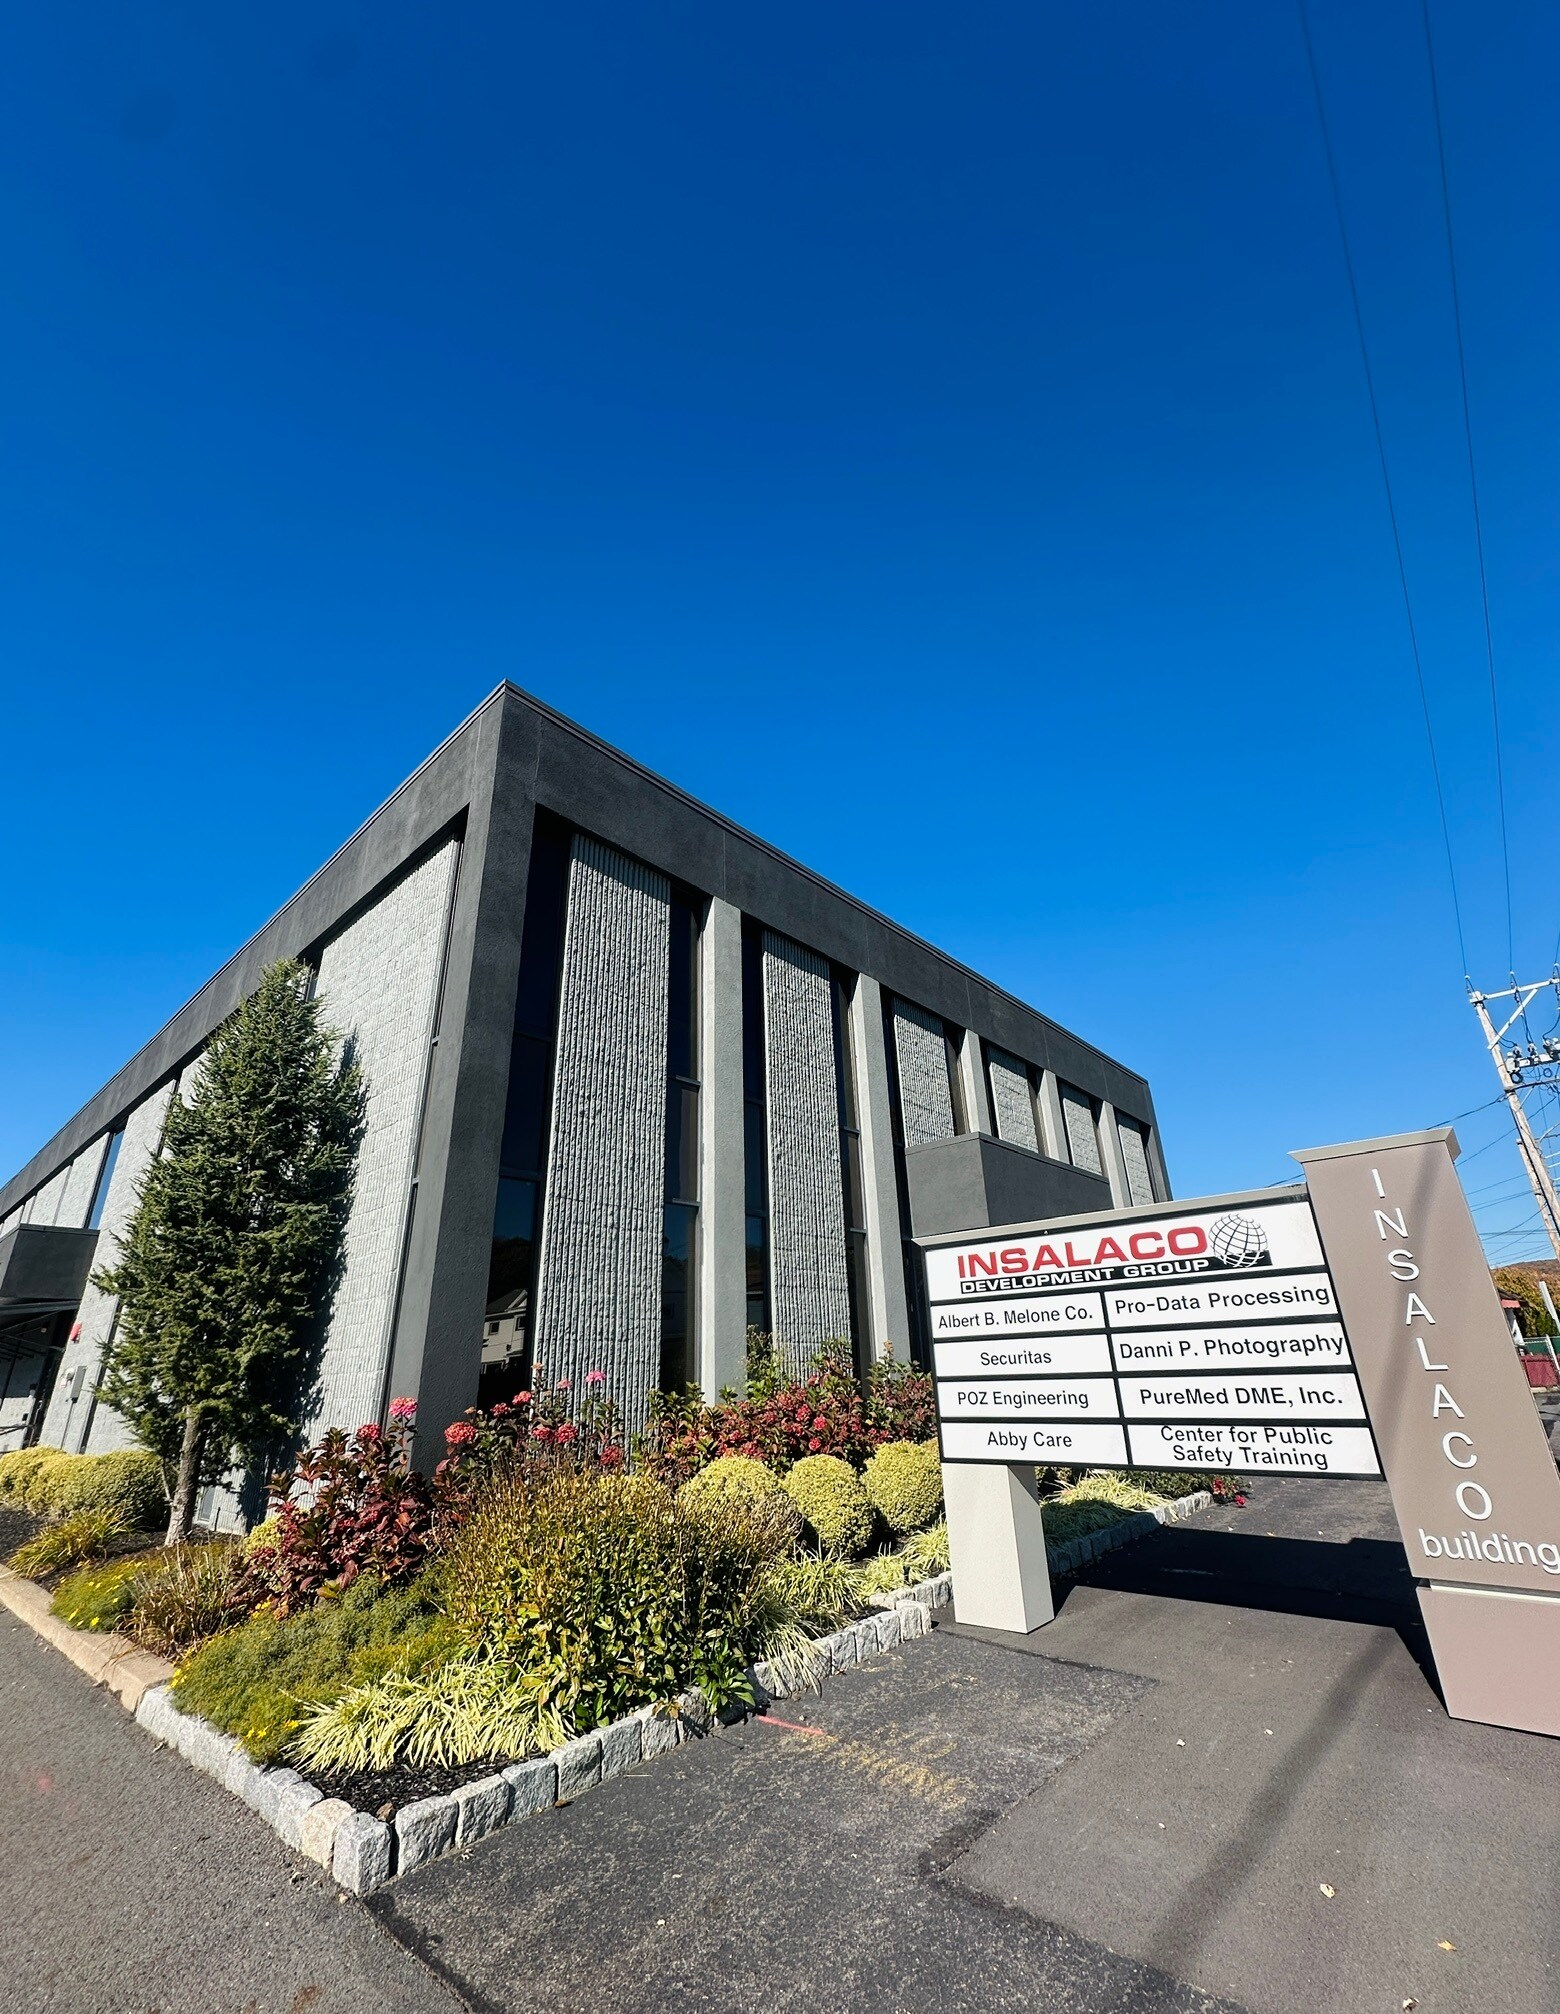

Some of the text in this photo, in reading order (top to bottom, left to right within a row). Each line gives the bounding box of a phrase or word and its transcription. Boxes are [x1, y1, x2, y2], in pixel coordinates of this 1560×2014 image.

[957, 1226, 1207, 1279] INSALACO
[961, 1259, 1209, 1294] DEVELOPMENT GROUP
[1116, 1286, 1330, 1314] Pro-Data Processing
[938, 1305, 1093, 1329] Albert B. Melone Co.
[1120, 1335, 1343, 1359] Danni P. Photography
[1371, 1168, 1493, 1521] INSALACO
[980, 1350, 1052, 1366] Securitas
[957, 1391, 1088, 1408] POZ Engineering
[1140, 1388, 1343, 1407] PureMed DME, Inc.
[987, 1431, 1072, 1450] Abby Care
[1161, 1426, 1333, 1445] Center for Public
[1173, 1445, 1328, 1470] Safety Training
[1418, 1528, 1560, 1576] building
